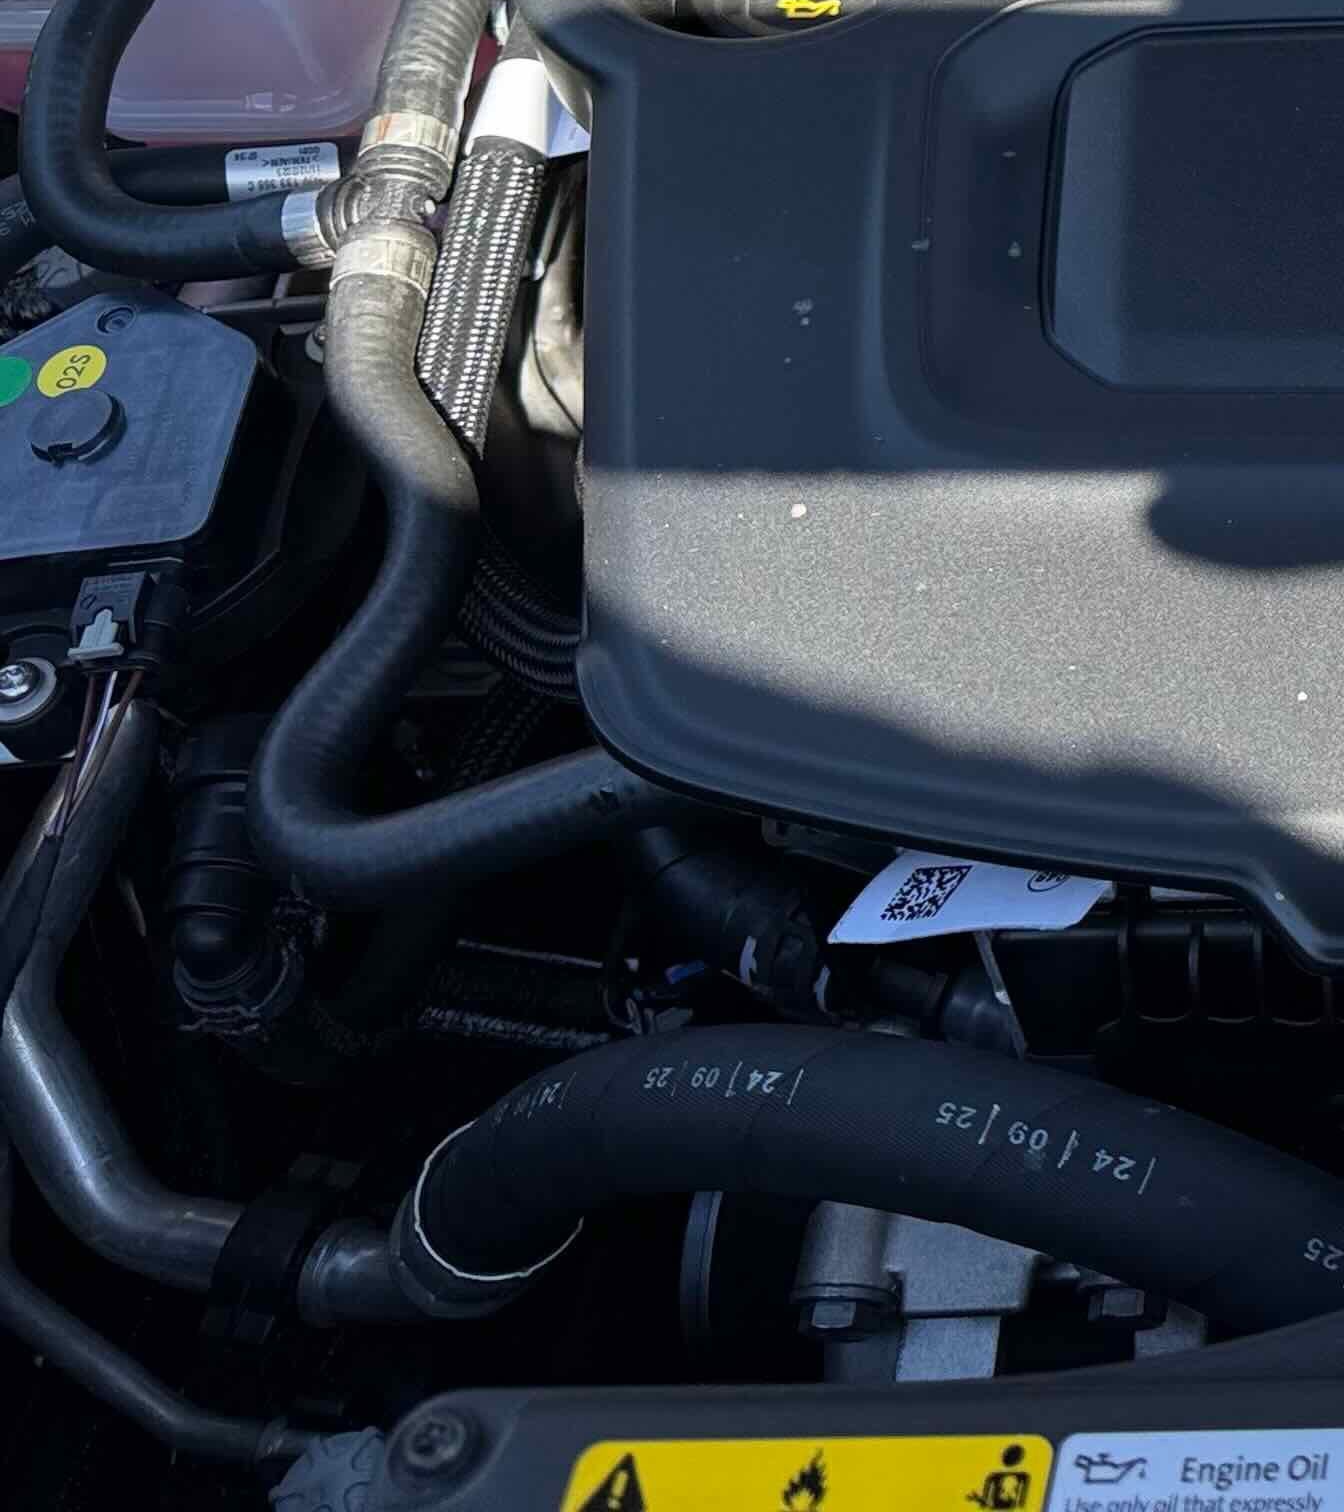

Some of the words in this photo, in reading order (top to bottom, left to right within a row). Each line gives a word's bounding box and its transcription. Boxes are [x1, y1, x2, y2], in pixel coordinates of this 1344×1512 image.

[1181, 1455, 1281, 1491] Engine
[1287, 1453, 1329, 1482] Oil
[1106, 1496, 1148, 1512] only
[1153, 1495, 1178, 1512] oil
[1183, 1494, 1224, 1512] that
[1230, 1492, 1323, 1512] expressly
